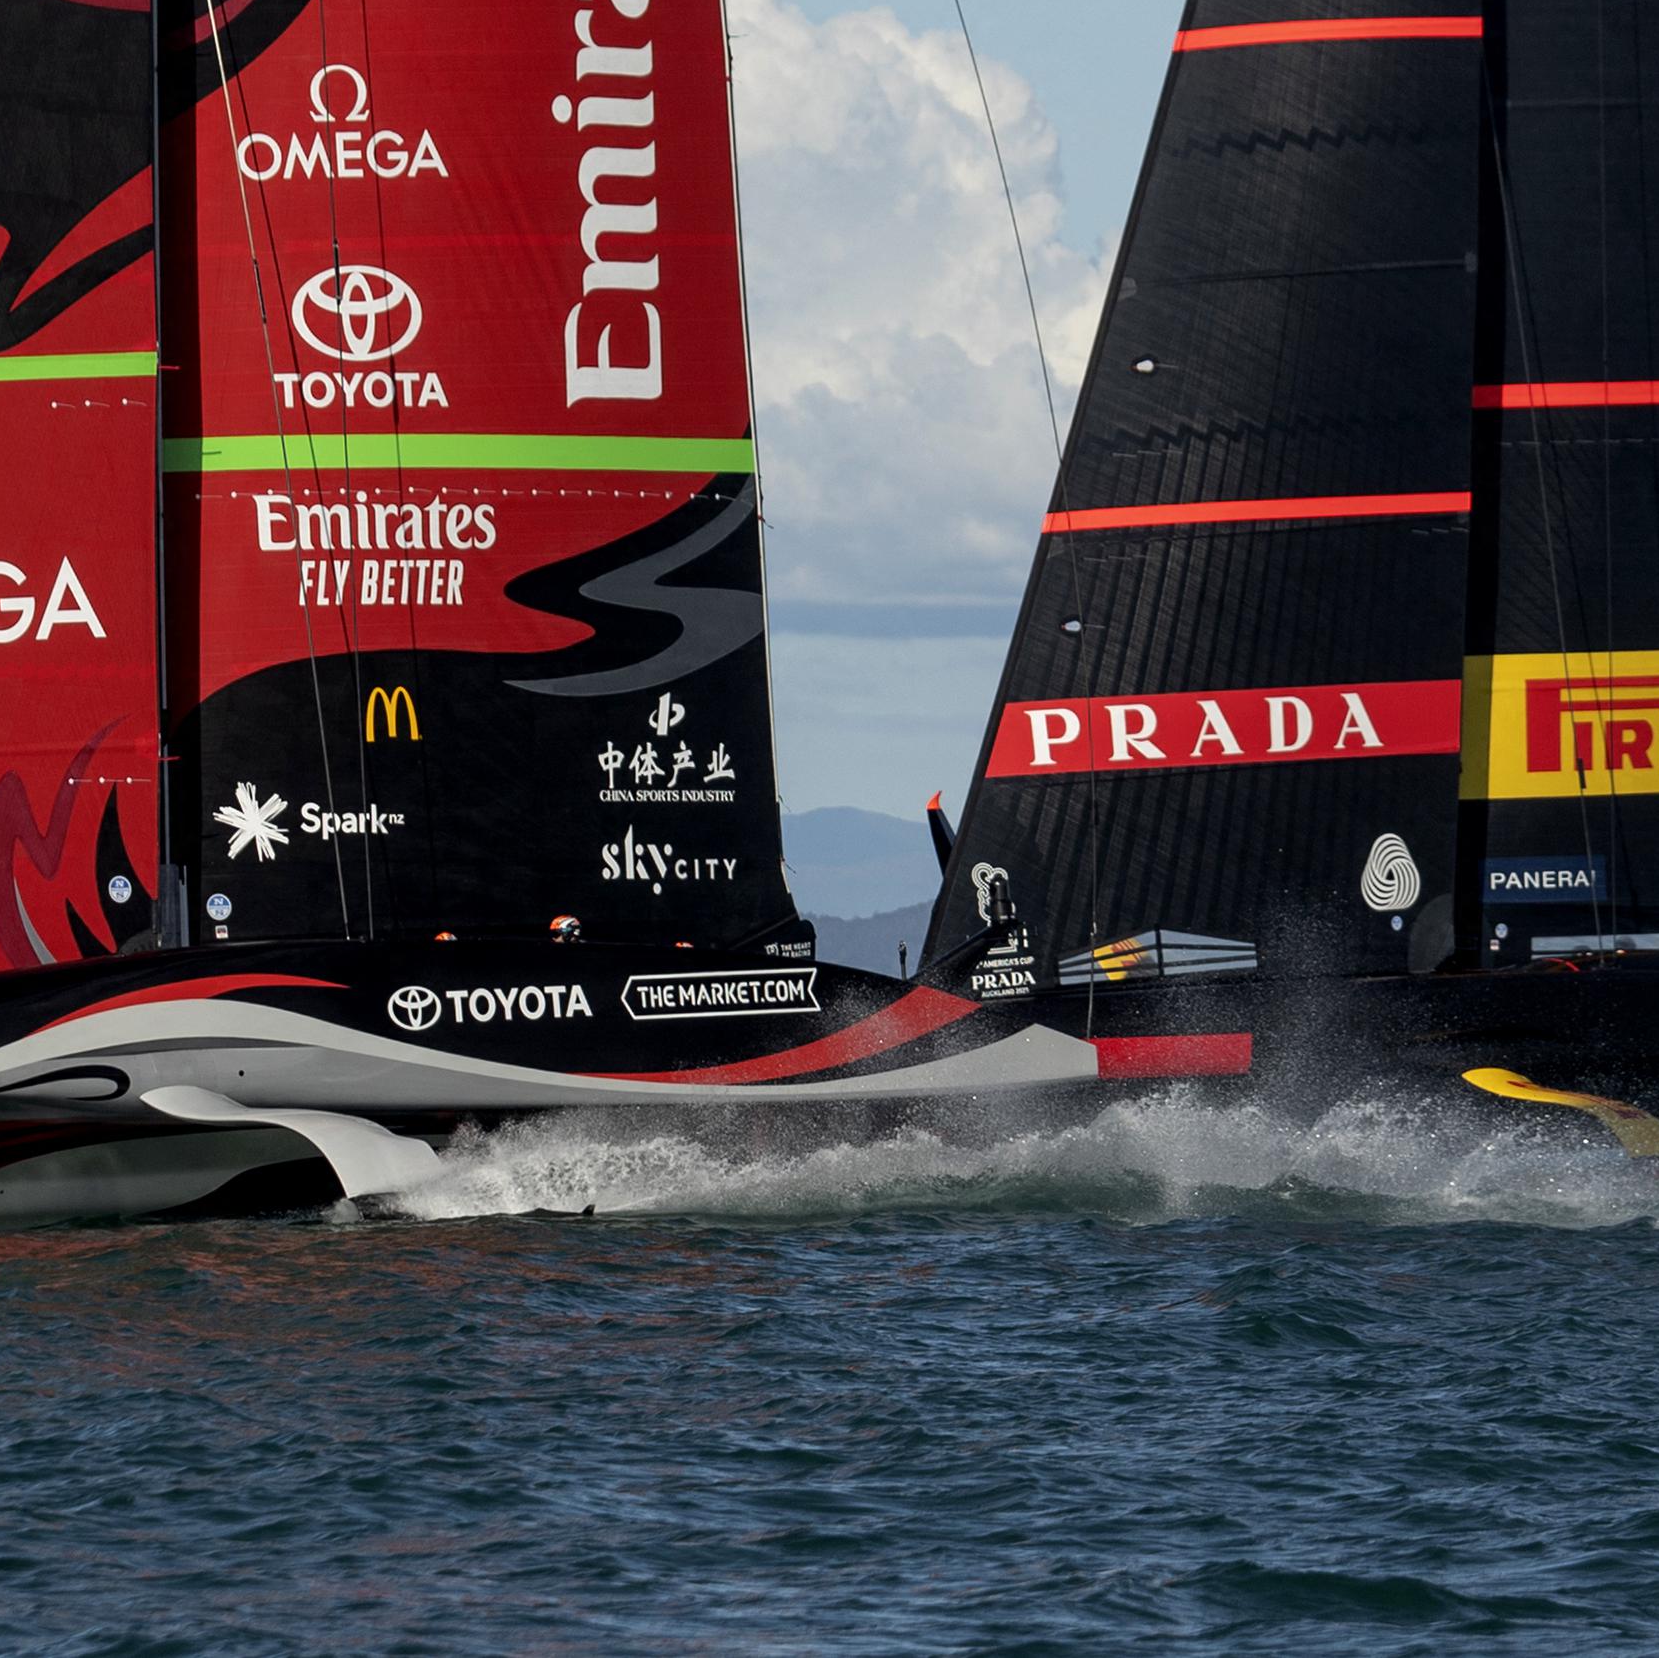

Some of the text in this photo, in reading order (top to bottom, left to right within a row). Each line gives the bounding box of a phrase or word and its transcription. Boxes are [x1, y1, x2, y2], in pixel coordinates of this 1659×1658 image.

[236, 128, 449, 180] OMEGA
[273, 373, 449, 409] TOYOTA
[252, 489, 497, 552] Emirates
[298, 558, 464, 607] FLY BETTER
[1024, 692, 1384, 766] PRADA
[598, 740, 736, 790] 中体产业
[599, 790, 736, 803] CHINA SPORTS INDUSTRY
[1489, 869, 1596, 890] PANERAI
[971, 970, 1037, 991] PRADA
[981, 988, 1015, 998] AUCKLAND
[446, 984, 593, 1023] TOYOTA
